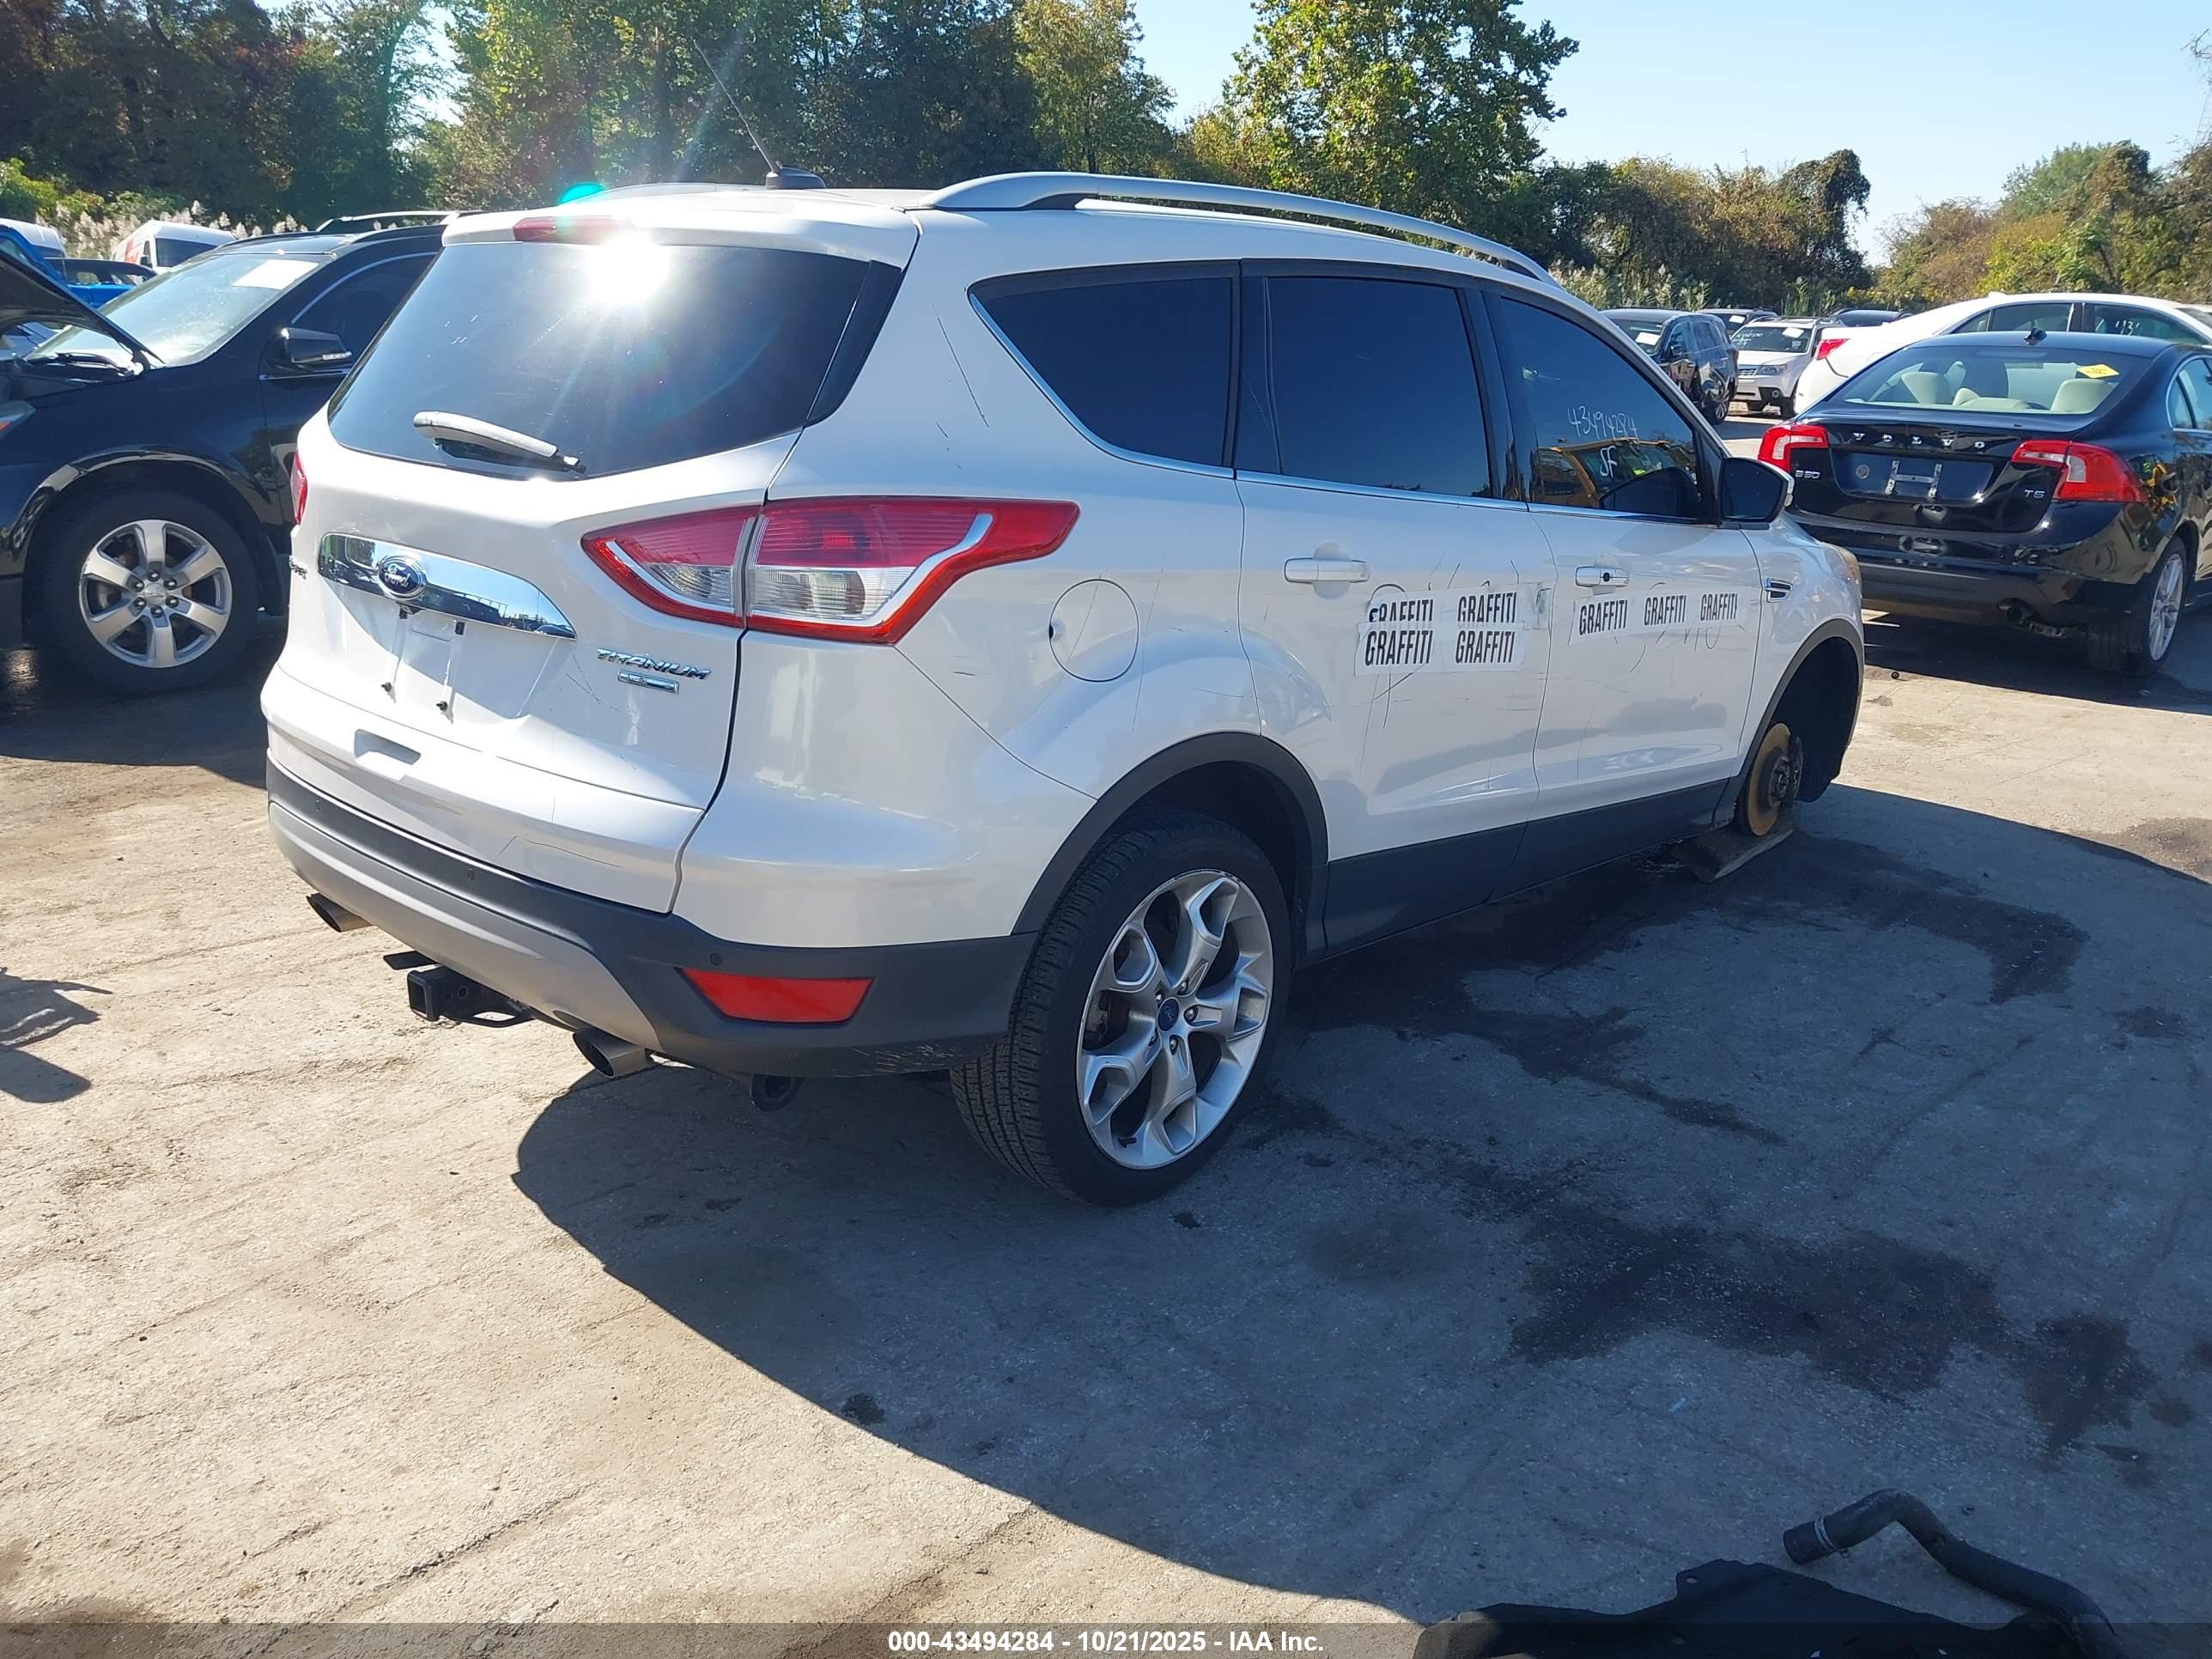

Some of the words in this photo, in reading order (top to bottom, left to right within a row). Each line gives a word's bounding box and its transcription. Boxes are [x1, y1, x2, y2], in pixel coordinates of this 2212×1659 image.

[1852, 432, 1985, 448] VOLVO
[2024, 489, 2045, 498] T5
[1457, 592, 1516, 623] GRAFFITI
[1579, 599, 1628, 635] GRAFFITI
[1644, 594, 1686, 626] GRAFFITI
[1700, 592, 1738, 622] GRAFFITI
[1364, 629, 1433, 665] GRAFFITI
[1455, 629, 1515, 664] GRAFFITI
[597, 647, 712, 680] TITANIUM
